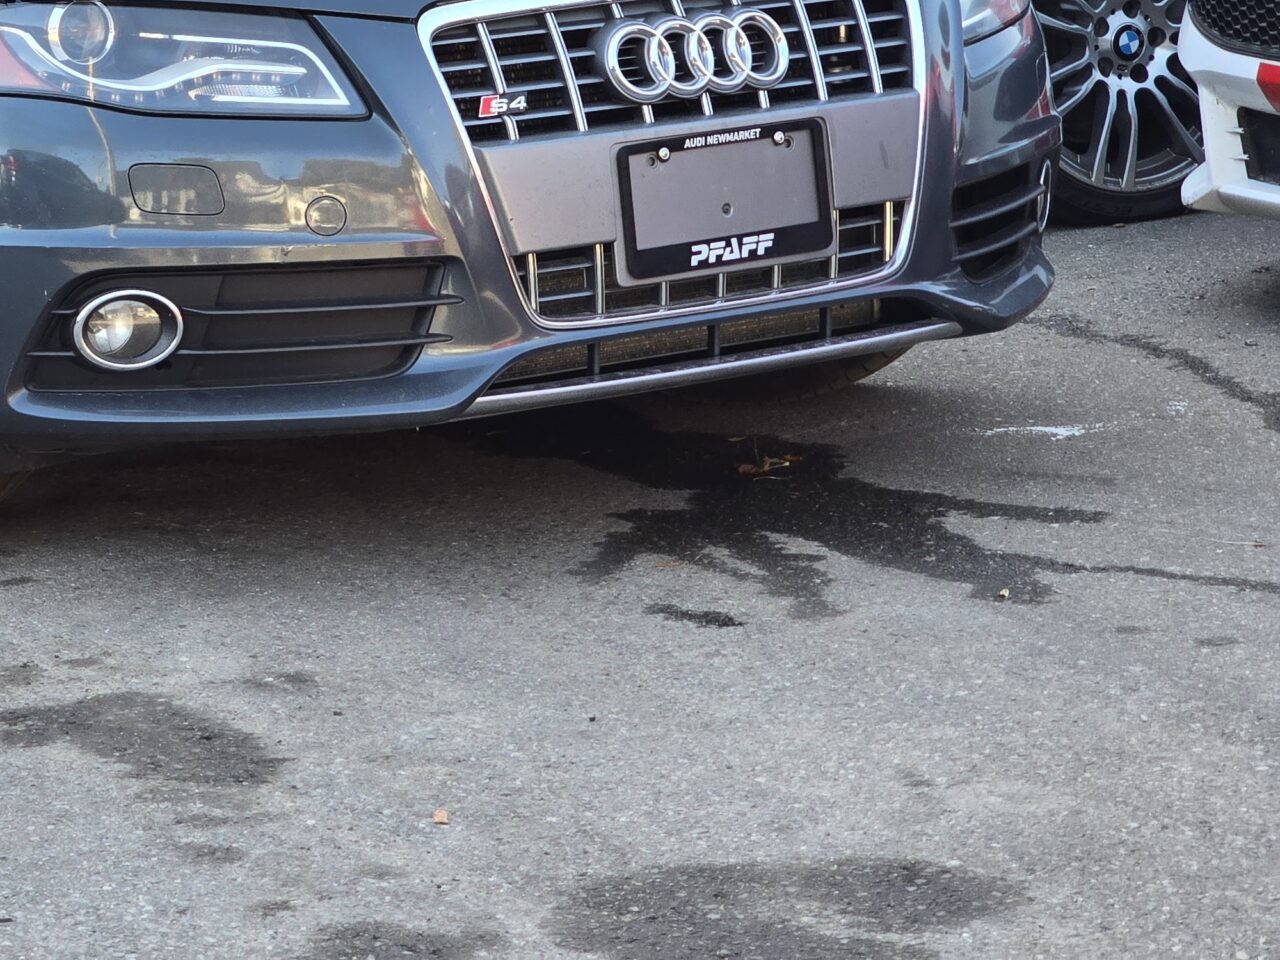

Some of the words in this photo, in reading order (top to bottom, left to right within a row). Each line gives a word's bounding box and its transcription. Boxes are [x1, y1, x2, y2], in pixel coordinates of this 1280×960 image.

[489, 95, 527, 113] S4
[683, 137, 706, 149] AUDI
[706, 128, 761, 144] NEWMARKET
[690, 233, 775, 267] PFAFF
